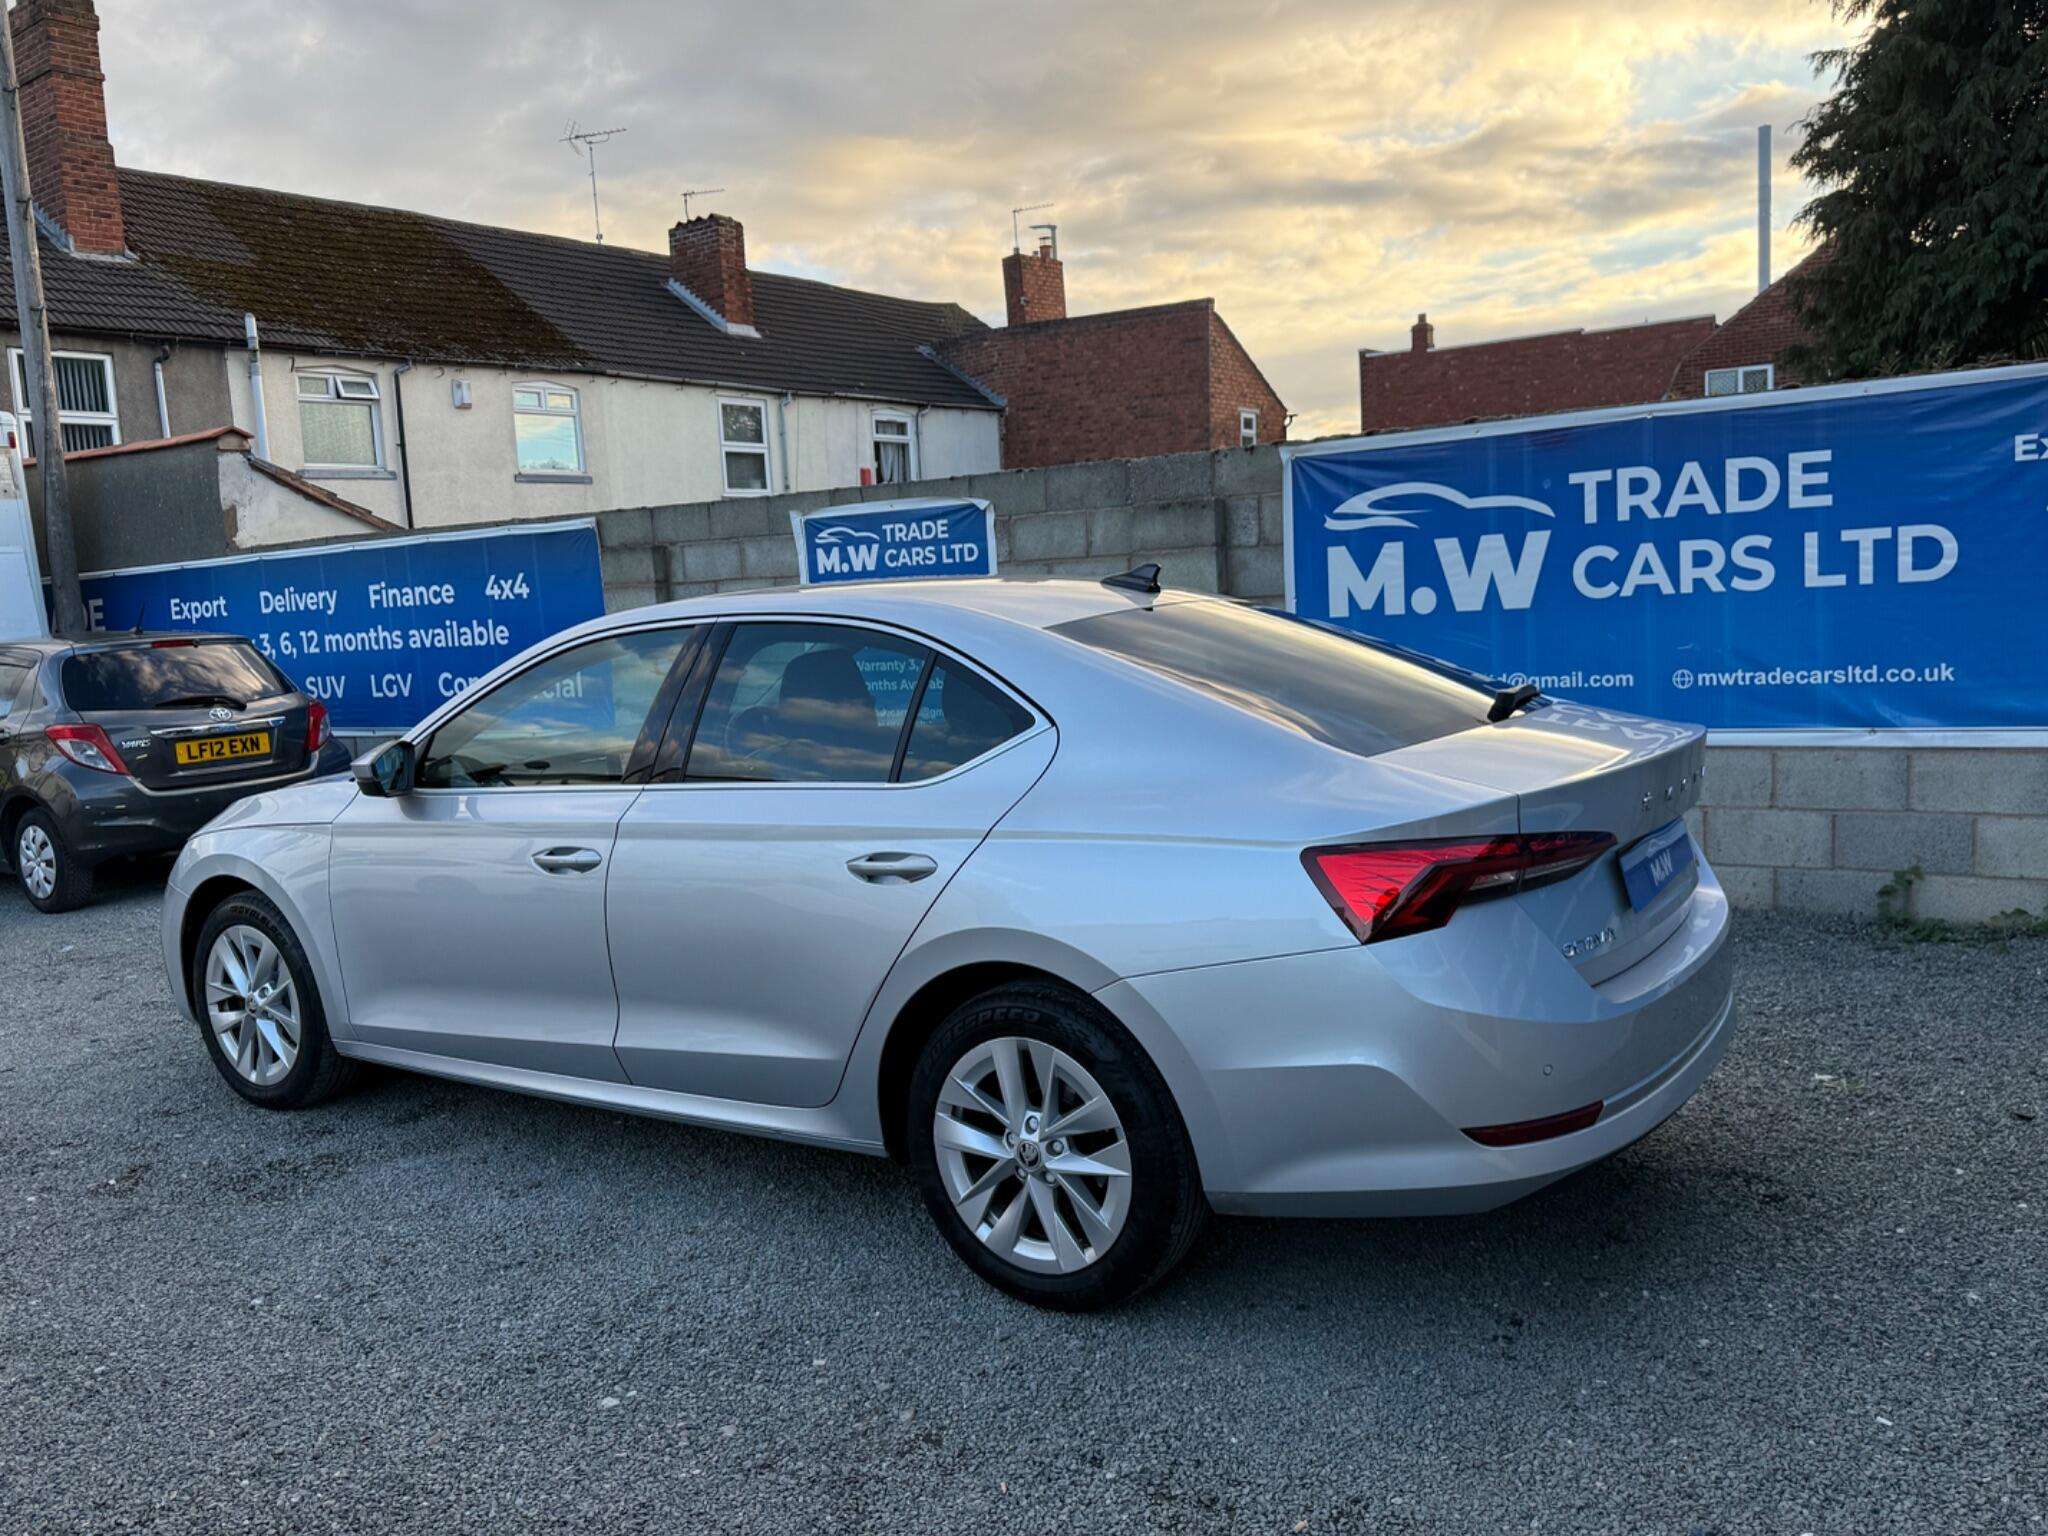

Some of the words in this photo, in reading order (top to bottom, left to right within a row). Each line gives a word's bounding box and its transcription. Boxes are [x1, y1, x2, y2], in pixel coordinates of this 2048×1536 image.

[1568, 449, 1833, 524] TRADE
[882, 519, 949, 543] TRADE
[816, 543, 879, 575] M.W
[884, 546, 936, 568] CARS
[942, 543, 979, 565] LTD
[1572, 534, 1776, 600] CARS
[1803, 523, 1959, 588] LTD
[1326, 530, 1552, 618] M.W
[170, 596, 228, 624] Export
[259, 586, 338, 616] Delivery
[368, 581, 455, 609] Finance
[485, 572, 530, 600] 4x4
[259, 633, 276, 660] 3,
[280, 631, 298, 660] 6,
[299, 629, 320, 654] 12
[324, 624, 403, 653] months
[408, 618, 510, 649] available
[305, 674, 346, 700] SUV
[370, 672, 413, 698] LGV
[1697, 663, 1955, 689] mwtradecarsltd.co.uk
[186, 740, 226, 761] LF12
[230, 737, 260, 755] EXN
